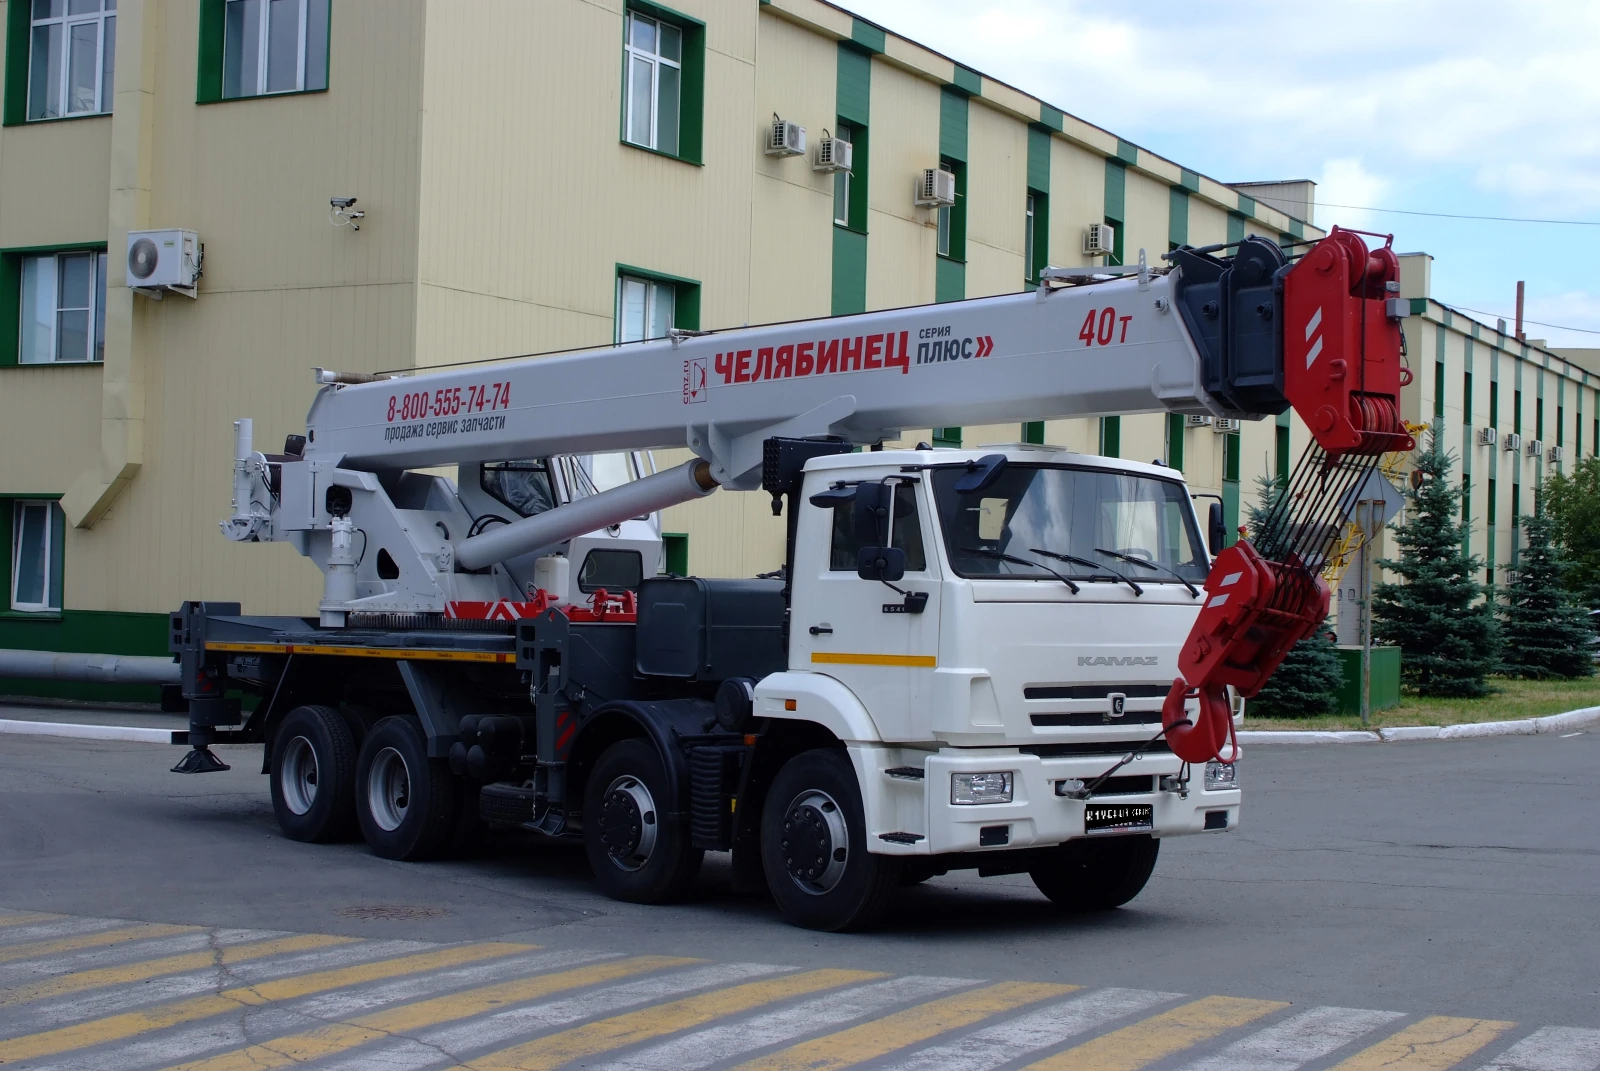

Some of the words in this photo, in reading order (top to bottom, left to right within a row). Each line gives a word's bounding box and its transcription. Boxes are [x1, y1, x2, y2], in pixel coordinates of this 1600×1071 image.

[918, 325, 951, 339] СЕРИЯ
[714, 330, 910, 375] ЧЕЛЯБИНЕЦ
[916, 337, 973, 365] ПЛЮС
[387, 381, 511, 422] 8-800-555-74-74
[384, 424, 424, 443] продажа
[426, 420, 458, 439] сервис
[460, 415, 506, 433] запчасти
[1077, 656, 1158, 667] KAMAZ
